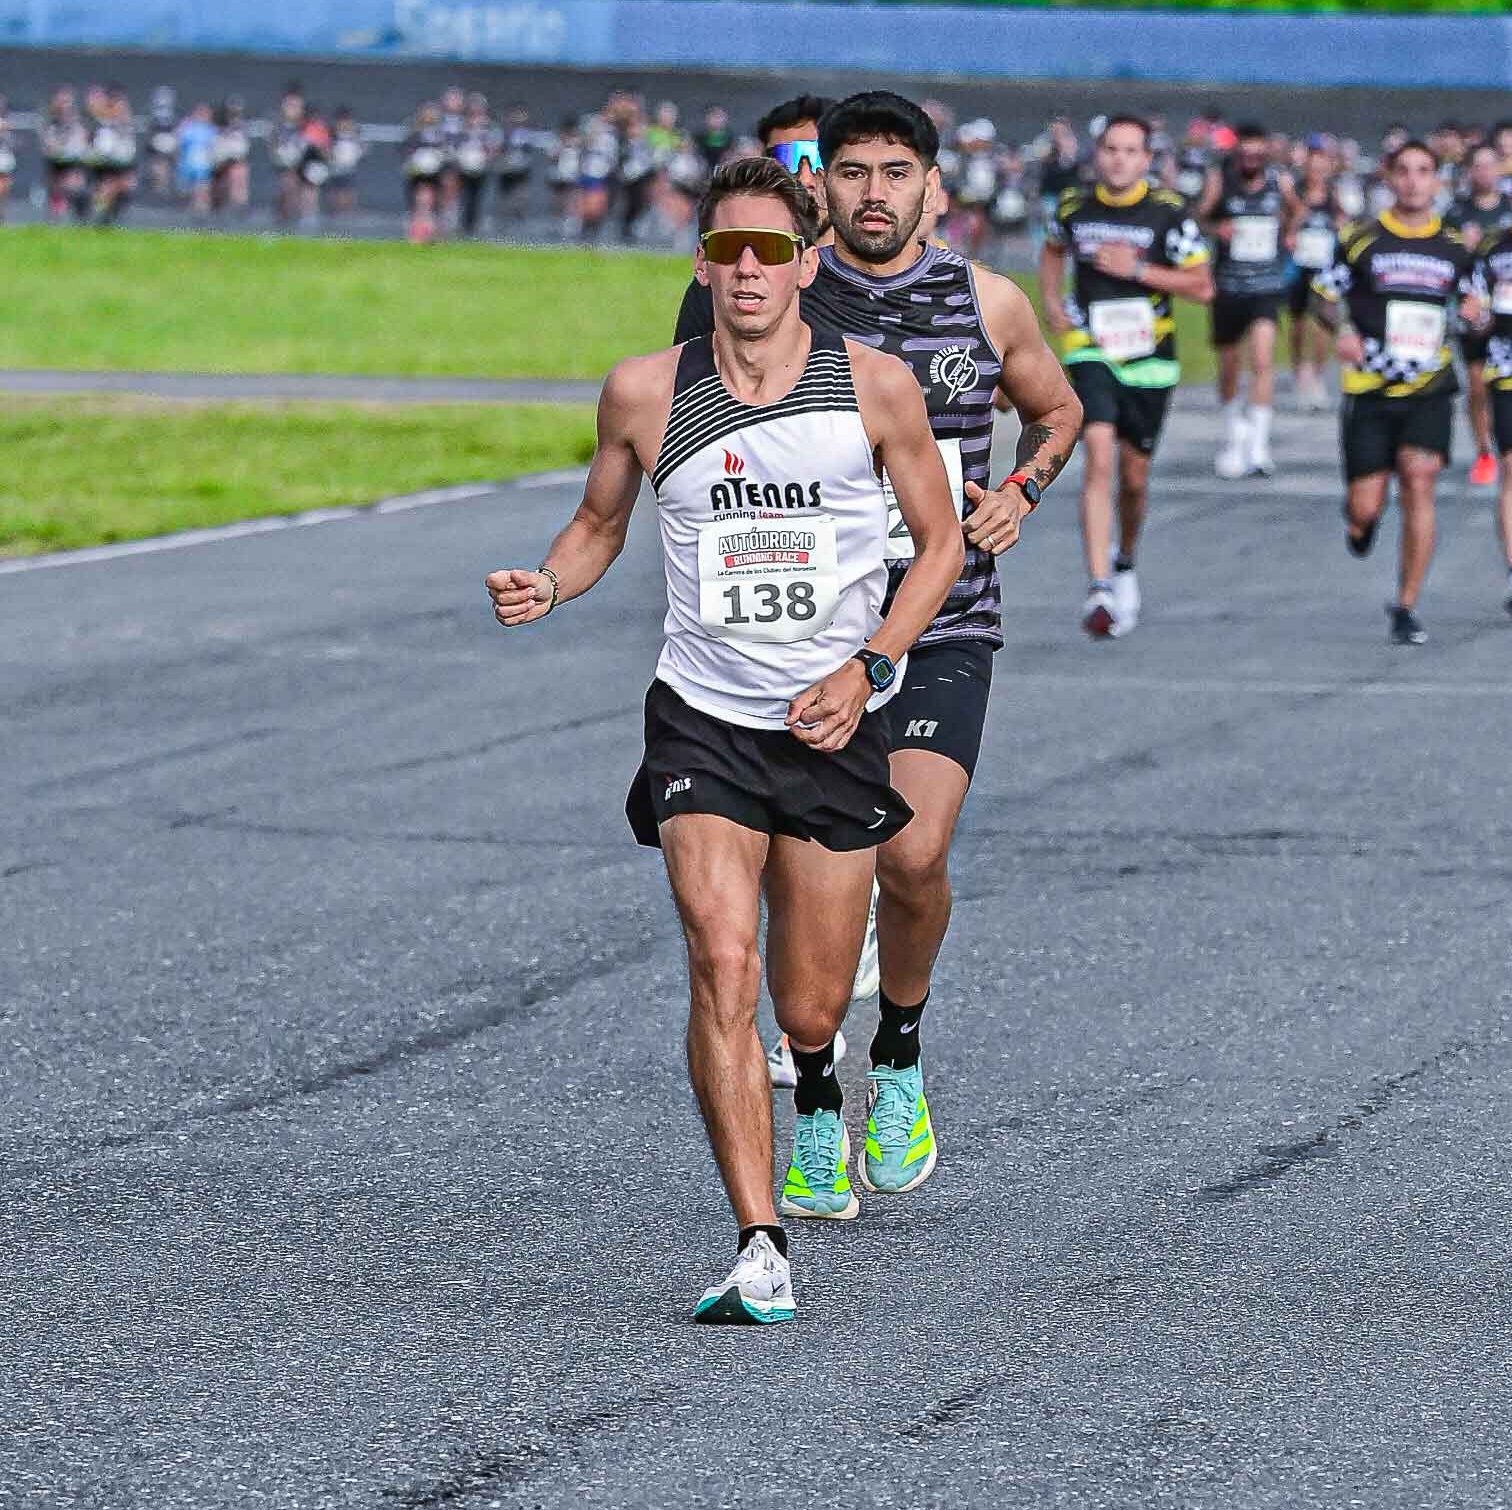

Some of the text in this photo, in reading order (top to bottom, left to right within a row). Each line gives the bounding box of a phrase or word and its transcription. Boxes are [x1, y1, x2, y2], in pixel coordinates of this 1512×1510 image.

[710, 477, 821, 511] ATENAS
[714, 509, 784, 522] running team
[718, 527, 815, 555] AUTÓDROMO
[733, 551, 799, 566] RUNNING RACE
[722, 581, 817, 625] 138
[904, 719, 939, 738] K1
